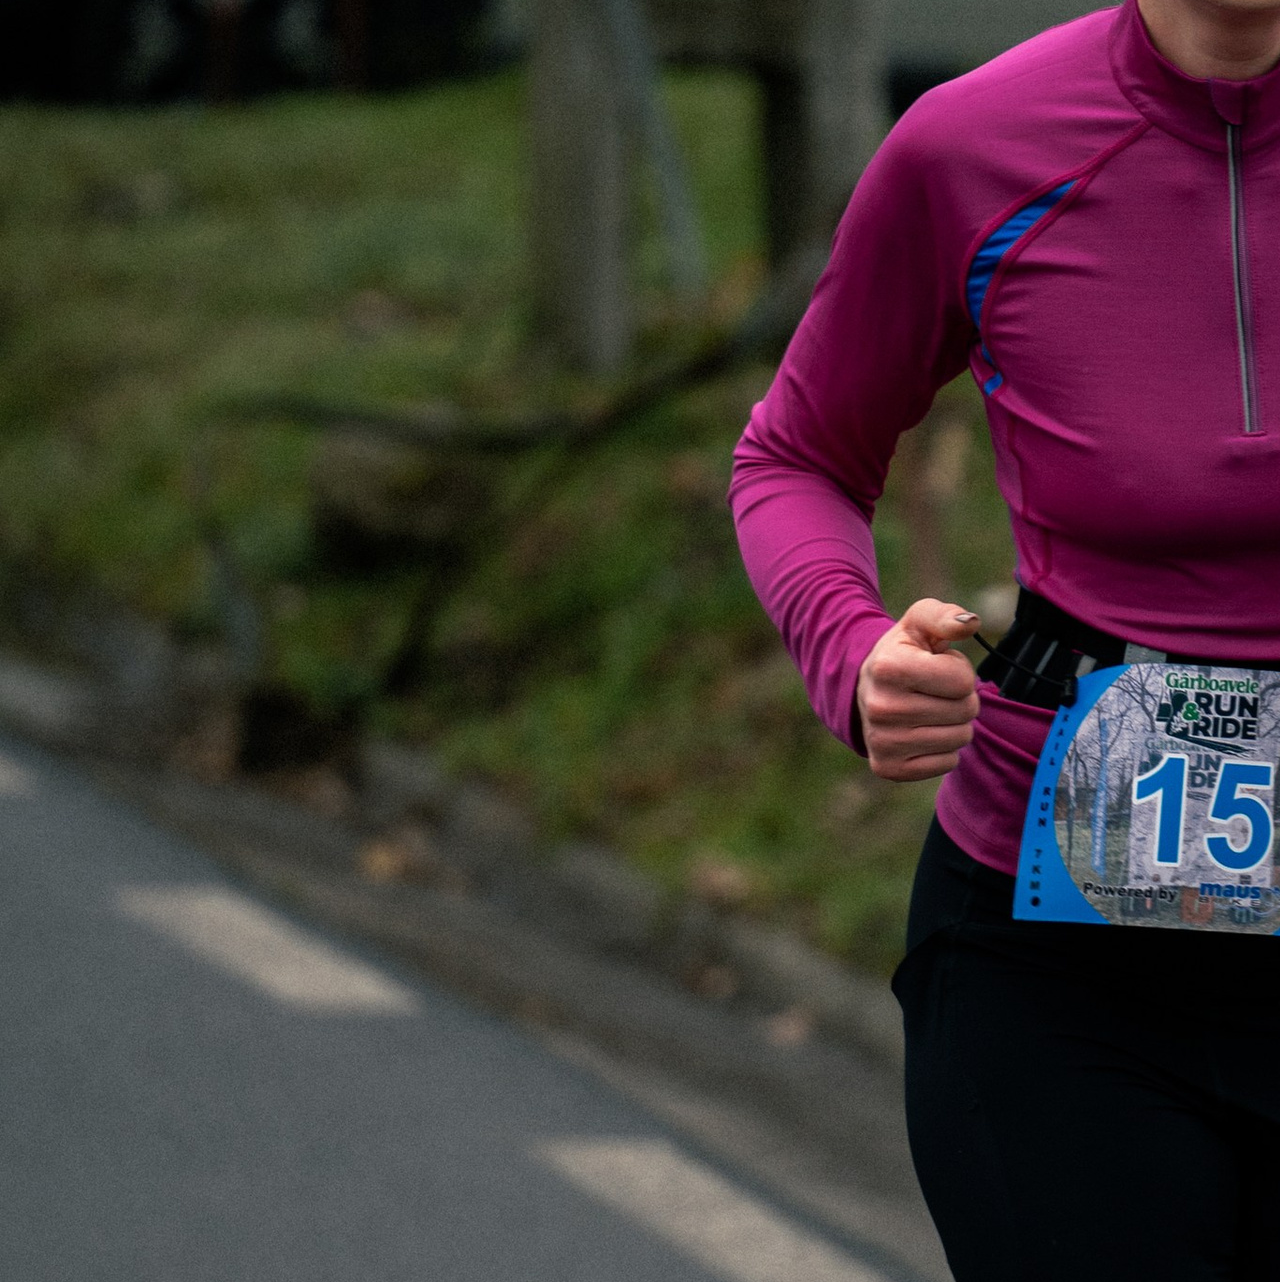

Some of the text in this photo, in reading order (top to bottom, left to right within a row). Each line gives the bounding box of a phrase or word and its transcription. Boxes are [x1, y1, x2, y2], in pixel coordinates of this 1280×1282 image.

[1165, 671, 1260, 694] Gârboavele
[1194, 692, 1260, 719] RUN
[1191, 716, 1259, 741] RIDE
[1133, 754, 1274, 873] 15
[1083, 882, 1178, 903] Powered by
[1199, 882, 1261, 900] maus
